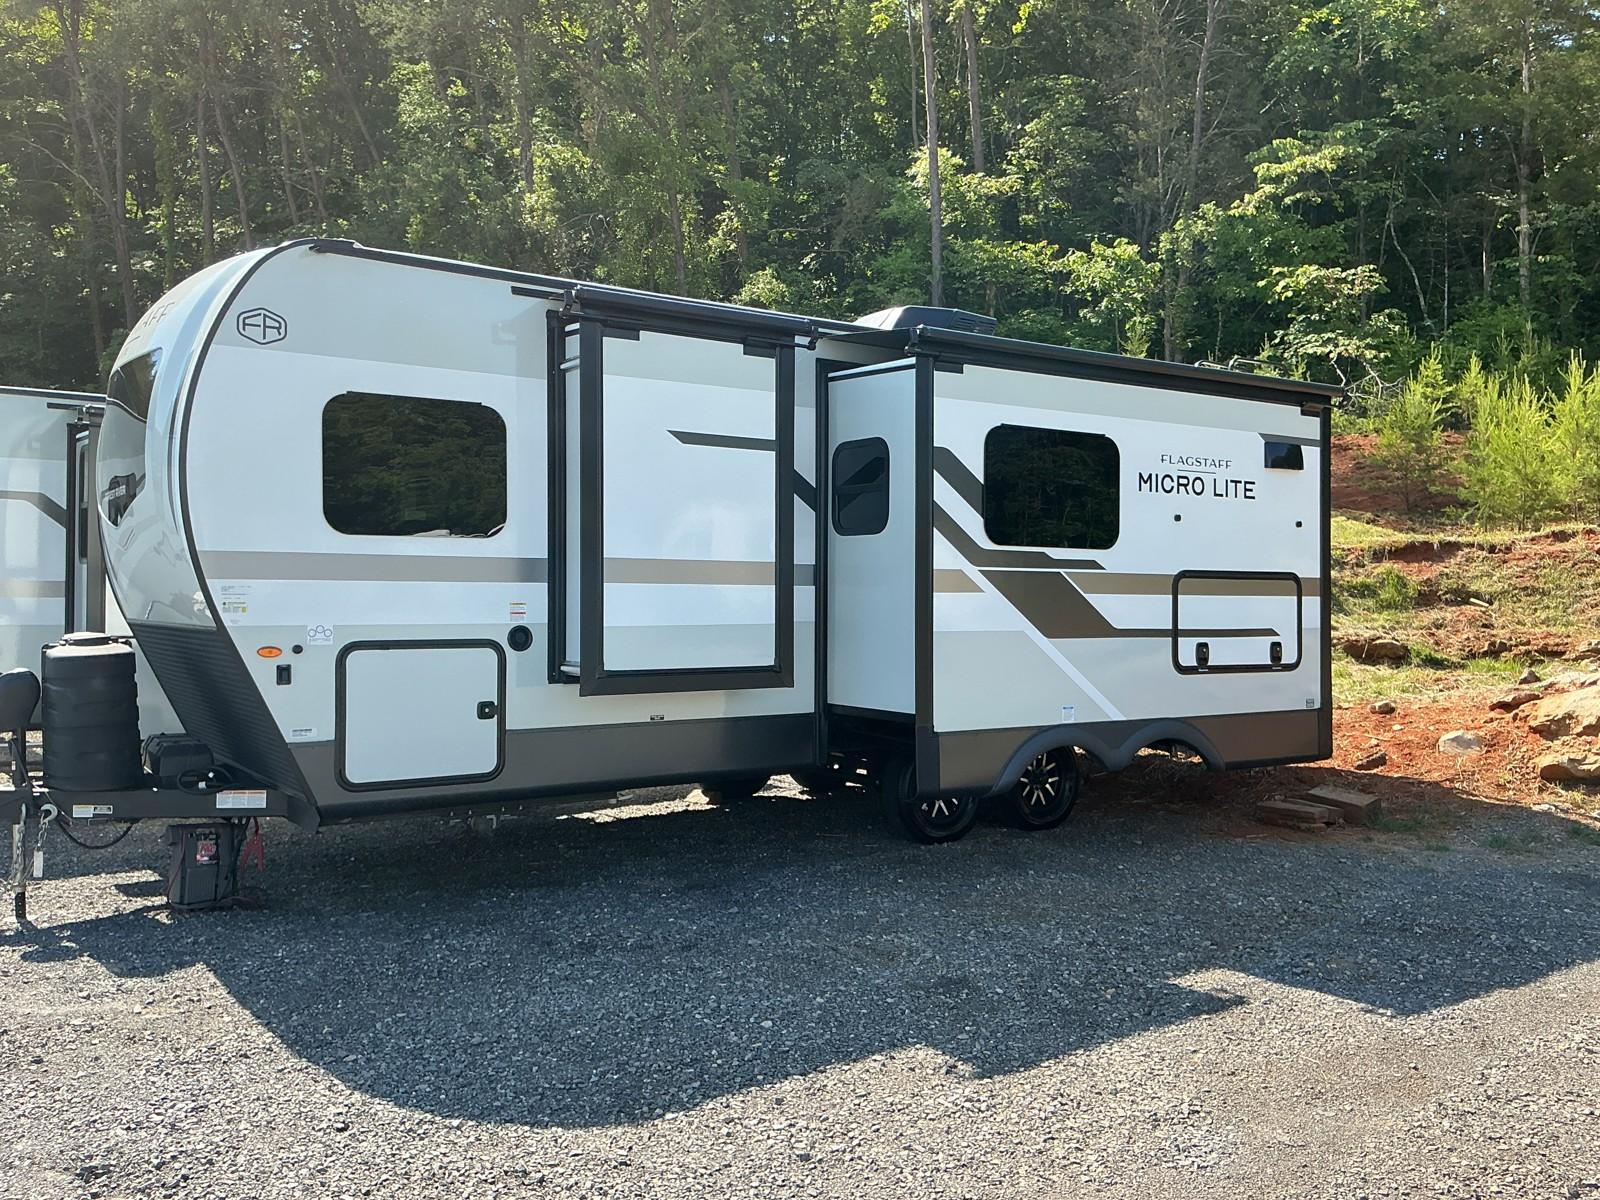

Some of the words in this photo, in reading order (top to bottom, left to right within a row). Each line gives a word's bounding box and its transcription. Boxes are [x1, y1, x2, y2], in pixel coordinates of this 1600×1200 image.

[1160, 454, 1232, 469] FLAGSTAFF
[1138, 472, 1205, 496] MICRO
[1213, 478, 1256, 500] LITE
